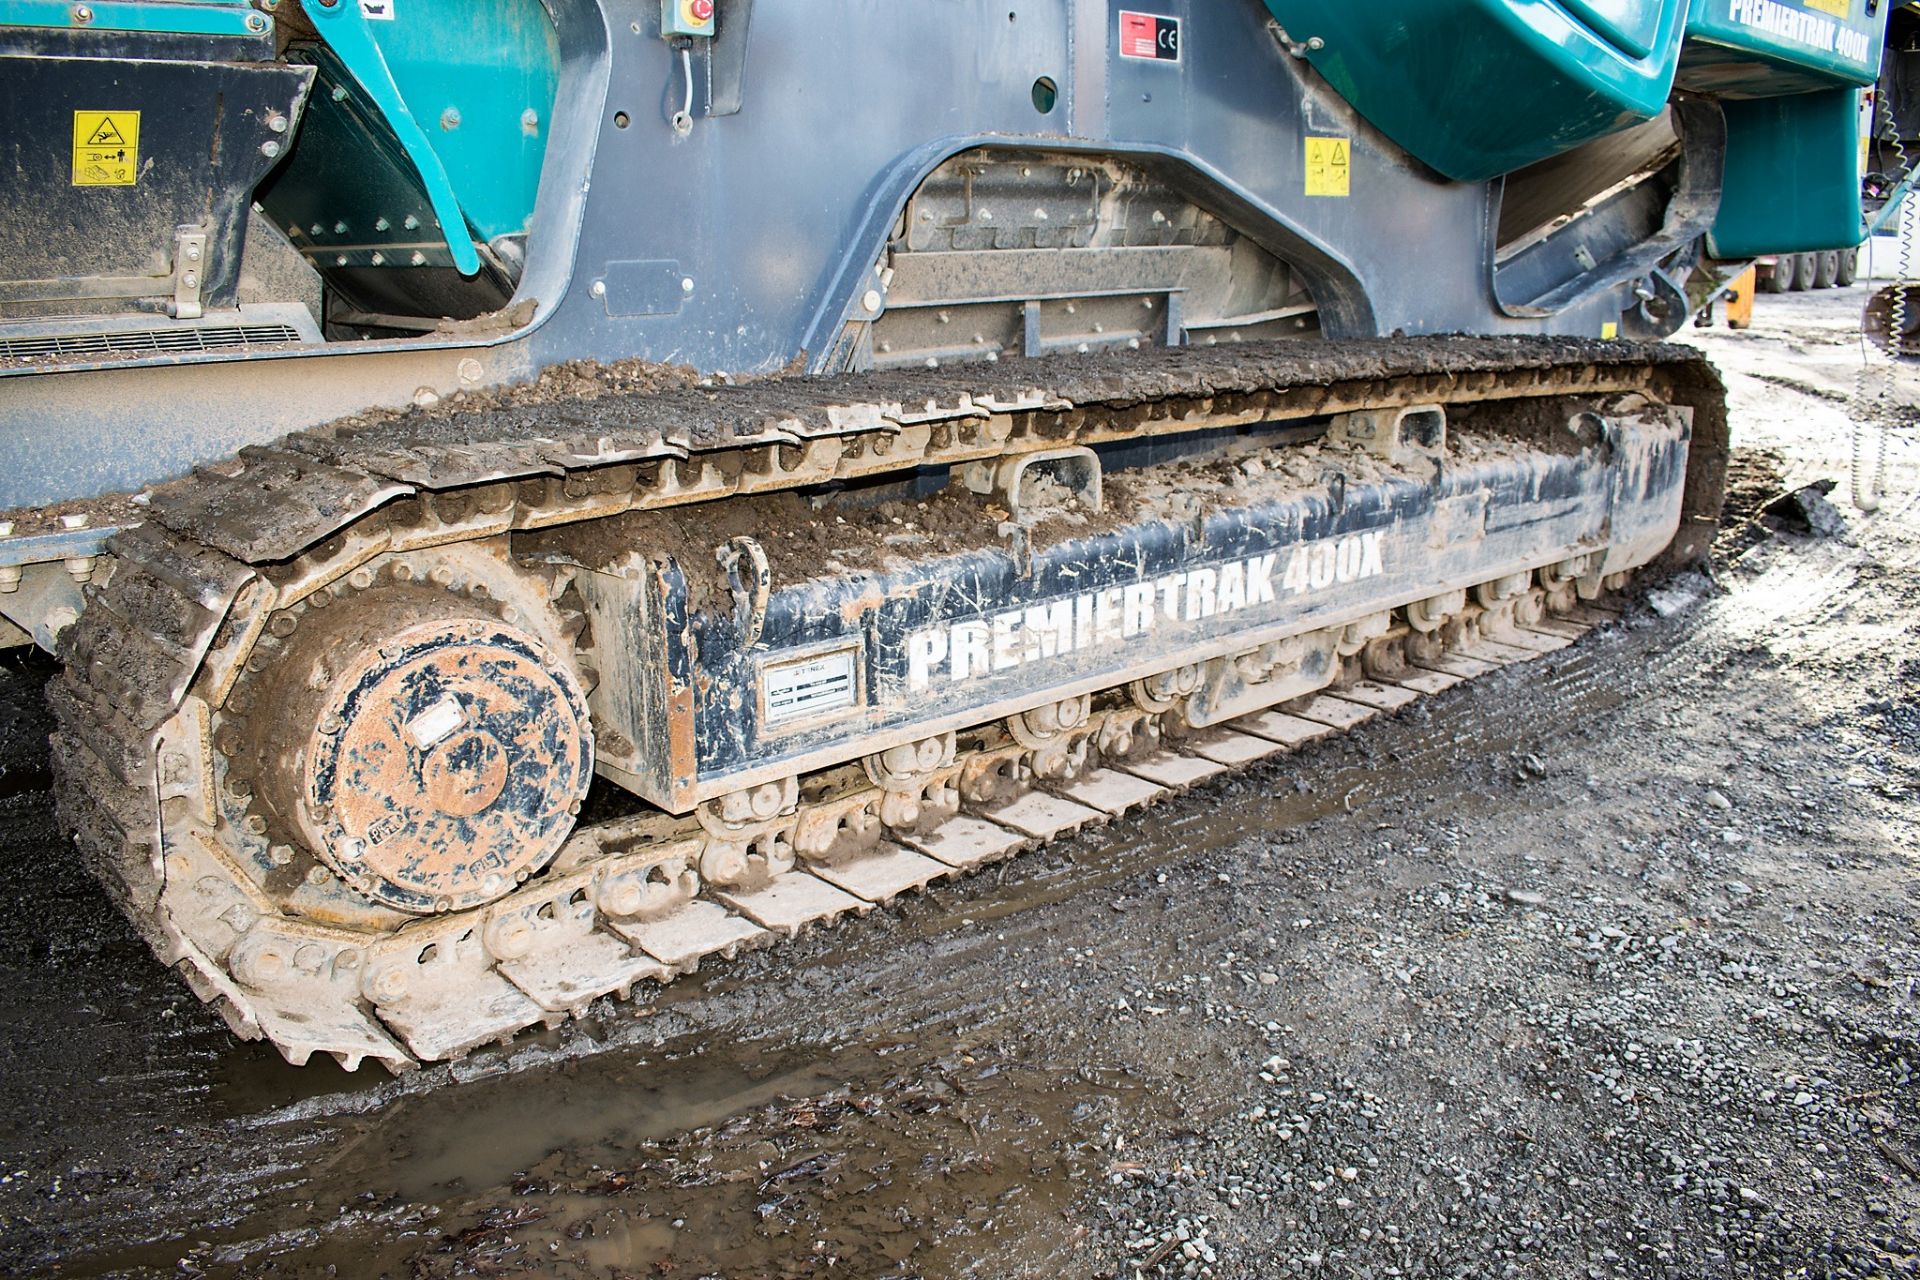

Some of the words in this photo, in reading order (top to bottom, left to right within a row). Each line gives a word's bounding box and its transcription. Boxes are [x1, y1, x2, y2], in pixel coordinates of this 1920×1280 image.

[1158, 28, 1177, 49] CE
[1729, 0, 1836, 52] PREMIERTRAK
[1835, 27, 1870, 63] 400X
[907, 553, 1278, 692] PREMIERTRAK
[1282, 529, 1387, 594] 400X
